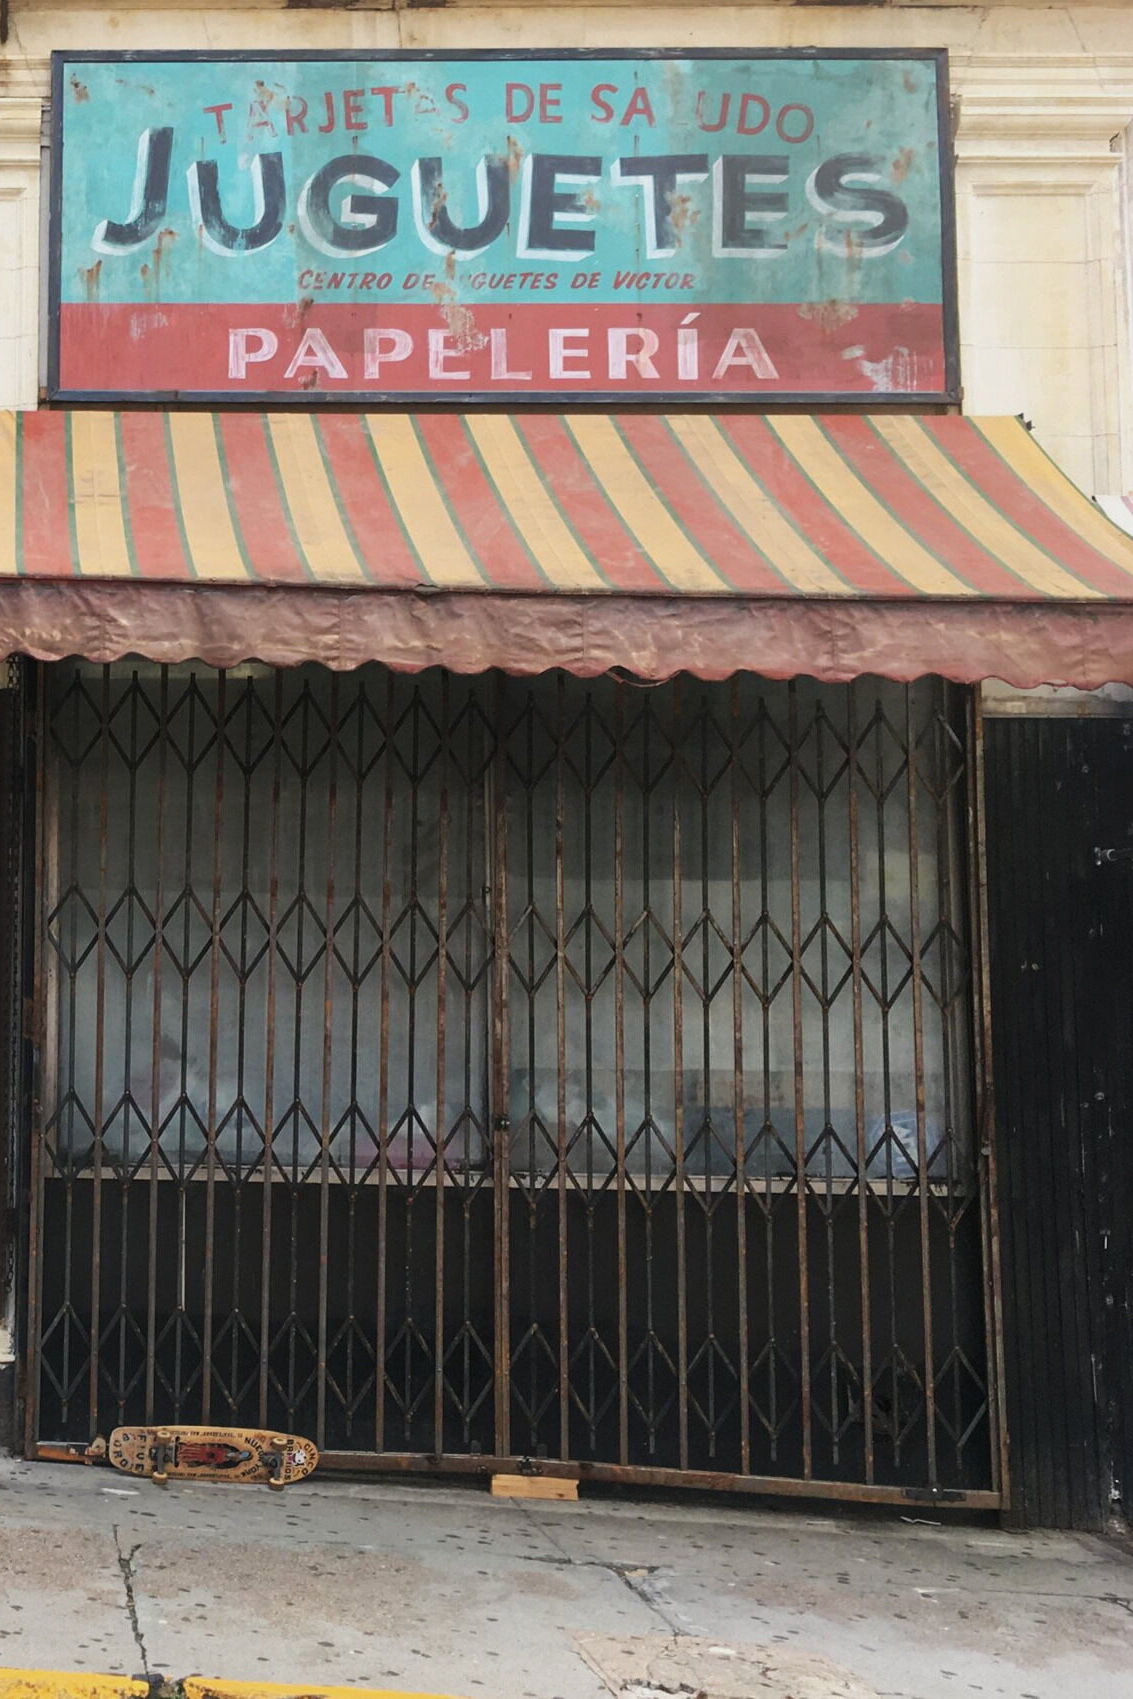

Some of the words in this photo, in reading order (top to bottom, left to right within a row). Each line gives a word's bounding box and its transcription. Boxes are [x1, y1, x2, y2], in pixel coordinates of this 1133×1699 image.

[505, 82, 563, 124] DE
[590, 83, 815, 144] SAUDO
[92, 126, 909, 261] JUGUETES
[298, 269, 394, 291] CENTRO
[402, 272, 437, 291] DE
[456, 270, 560, 291] GUETES
[570, 271, 603, 290] DE
[612, 270, 697, 291] VICTOR
[227, 313, 780, 381] PAPELERÍA
